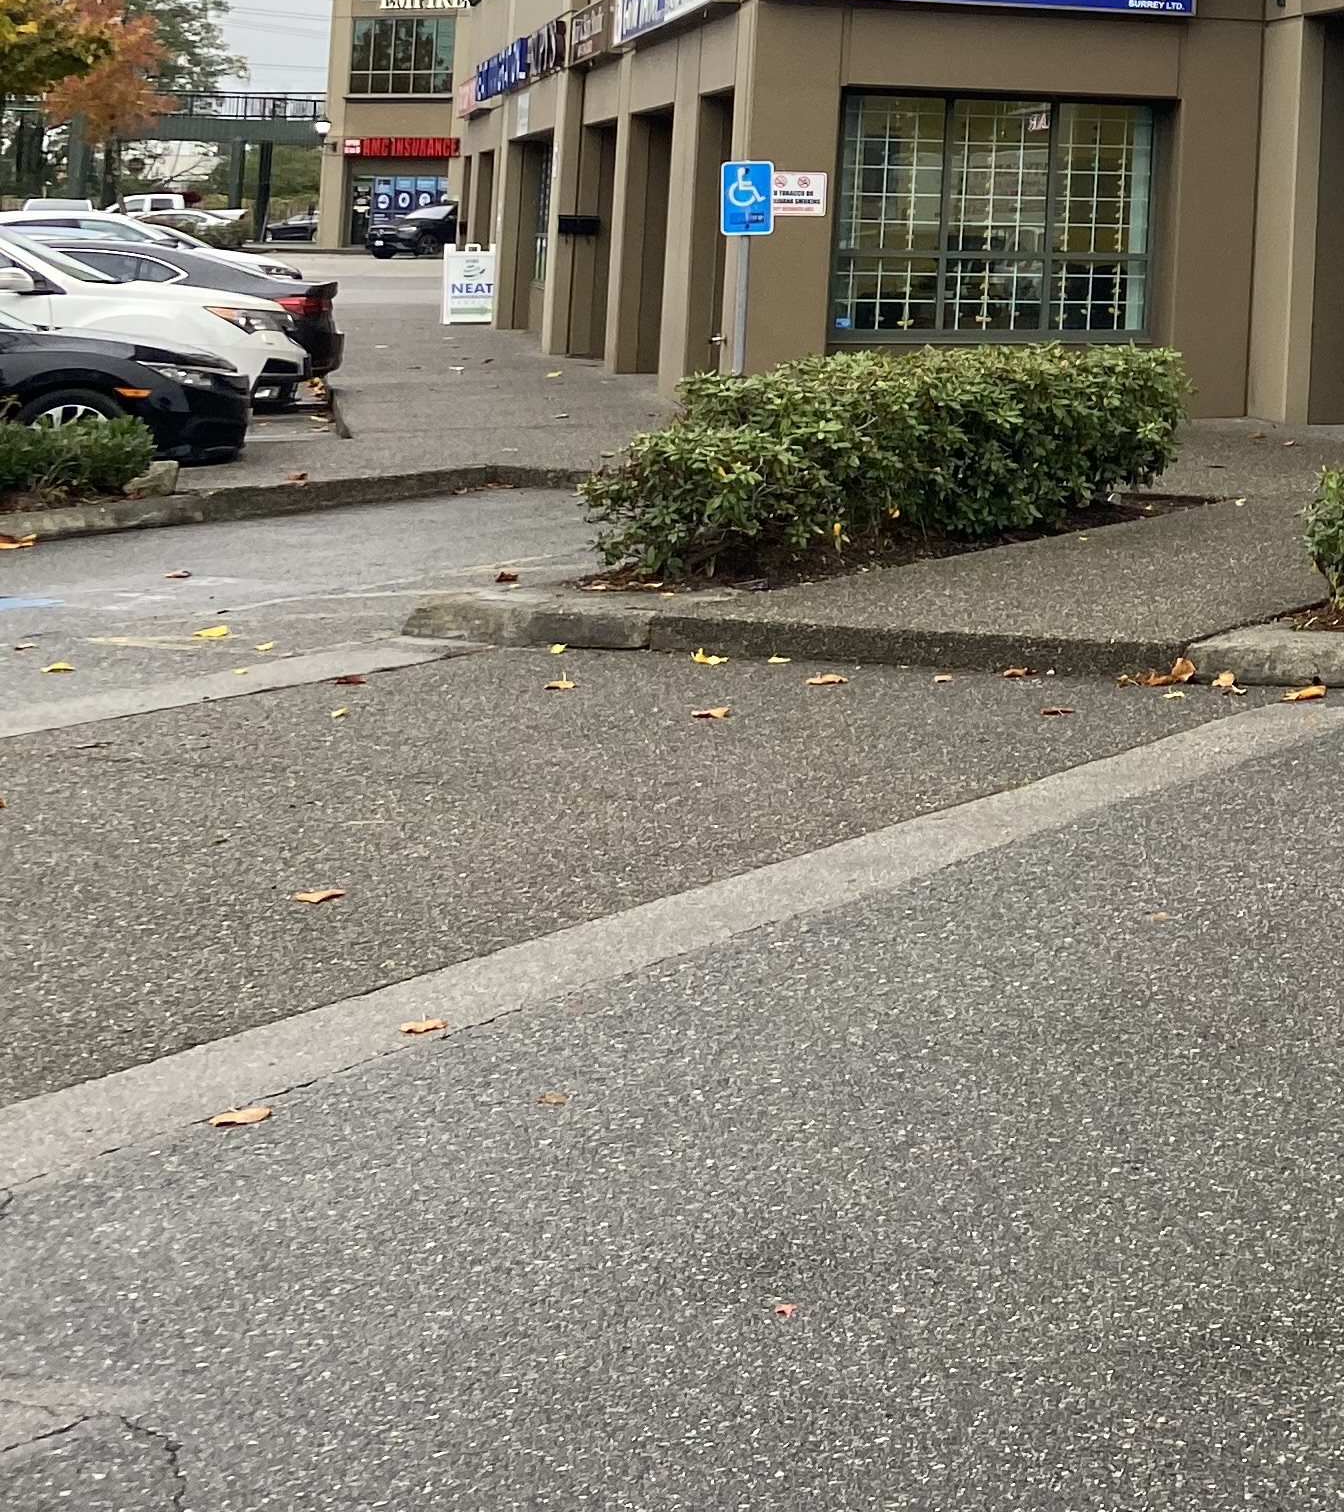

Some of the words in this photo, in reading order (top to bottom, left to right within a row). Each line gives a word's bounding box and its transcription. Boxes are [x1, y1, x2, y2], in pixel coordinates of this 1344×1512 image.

[1128, 0, 1165, 10] SURREY
[1166, 1, 1185, 11] LTD.
[451, 283, 494, 294] NEAT
